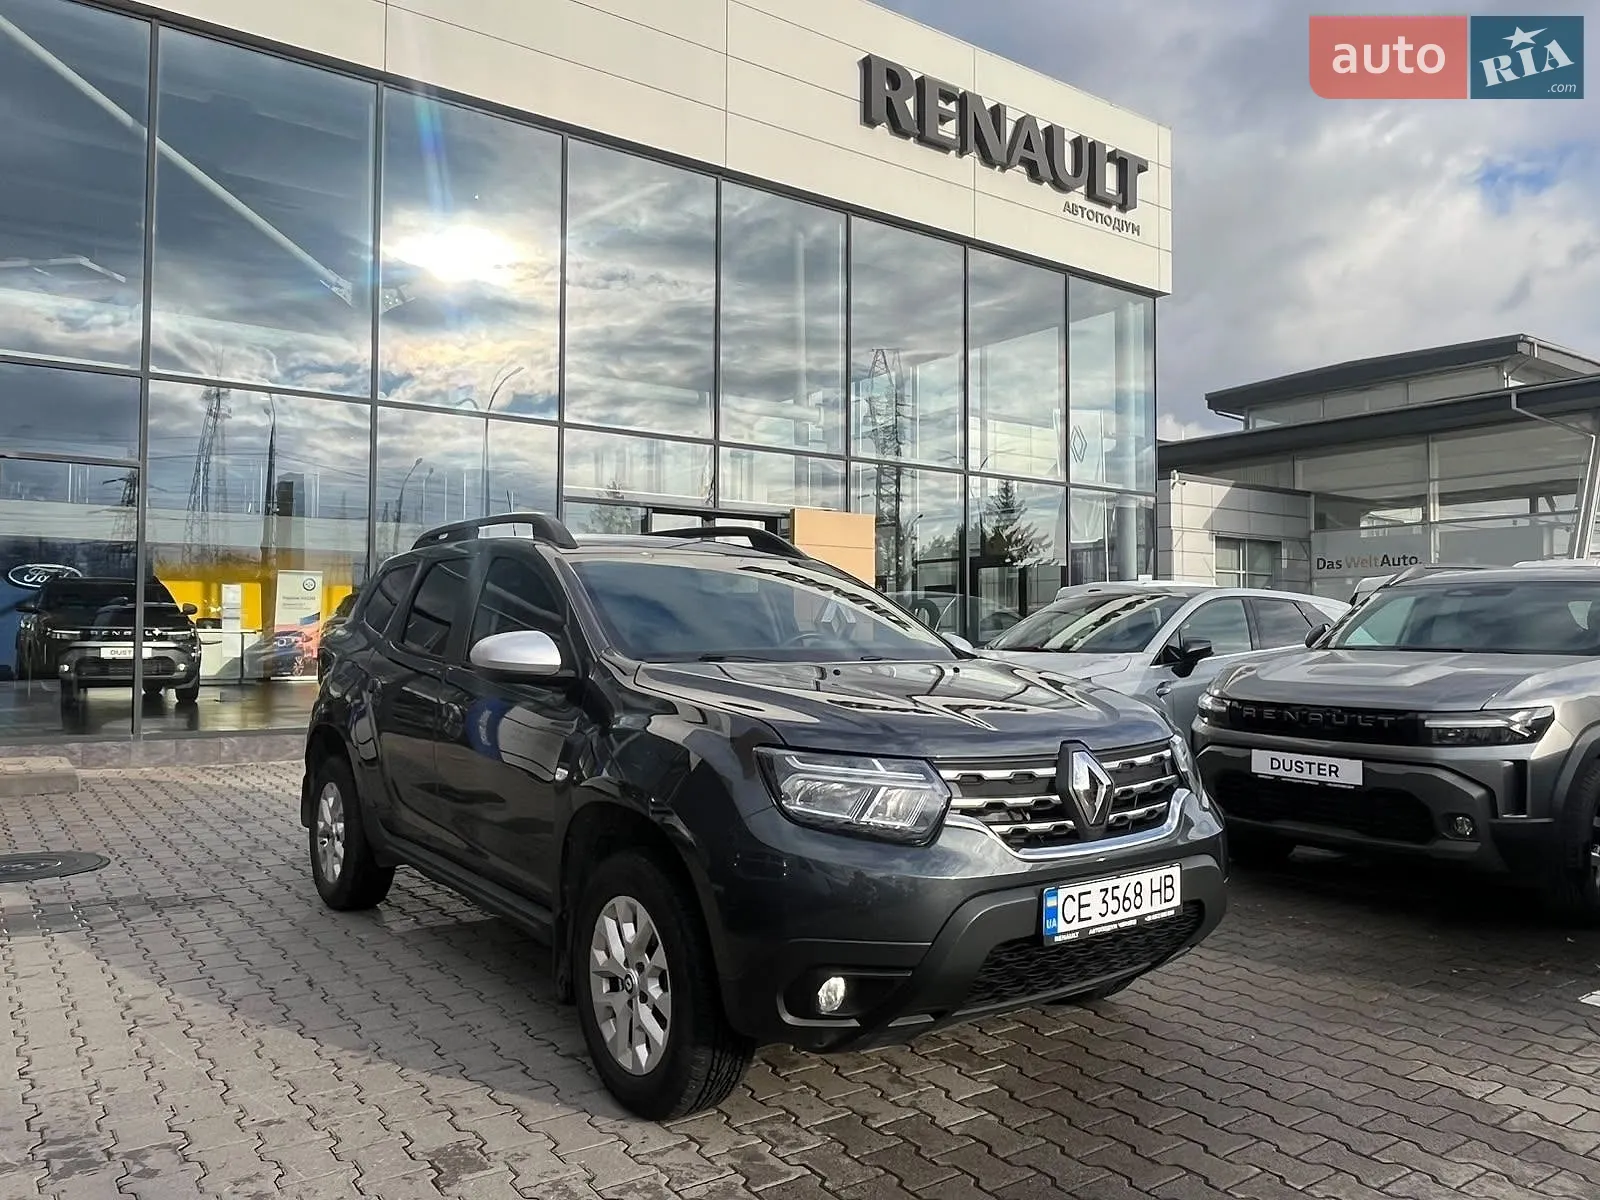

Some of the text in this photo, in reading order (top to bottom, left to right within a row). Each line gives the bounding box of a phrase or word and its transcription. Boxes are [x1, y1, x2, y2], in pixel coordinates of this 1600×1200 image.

[856, 53, 1149, 213] RENAULT
[1063, 200, 1140, 236] АВТОПОДІУМ
[1316, 557, 1343, 570] Das
[1242, 706, 1396, 729] RENAULT
[1270, 757, 1339, 778] DUSTER
[1061, 874, 1175, 924] CE 3568 HB
[1046, 919, 1057, 929] UA
